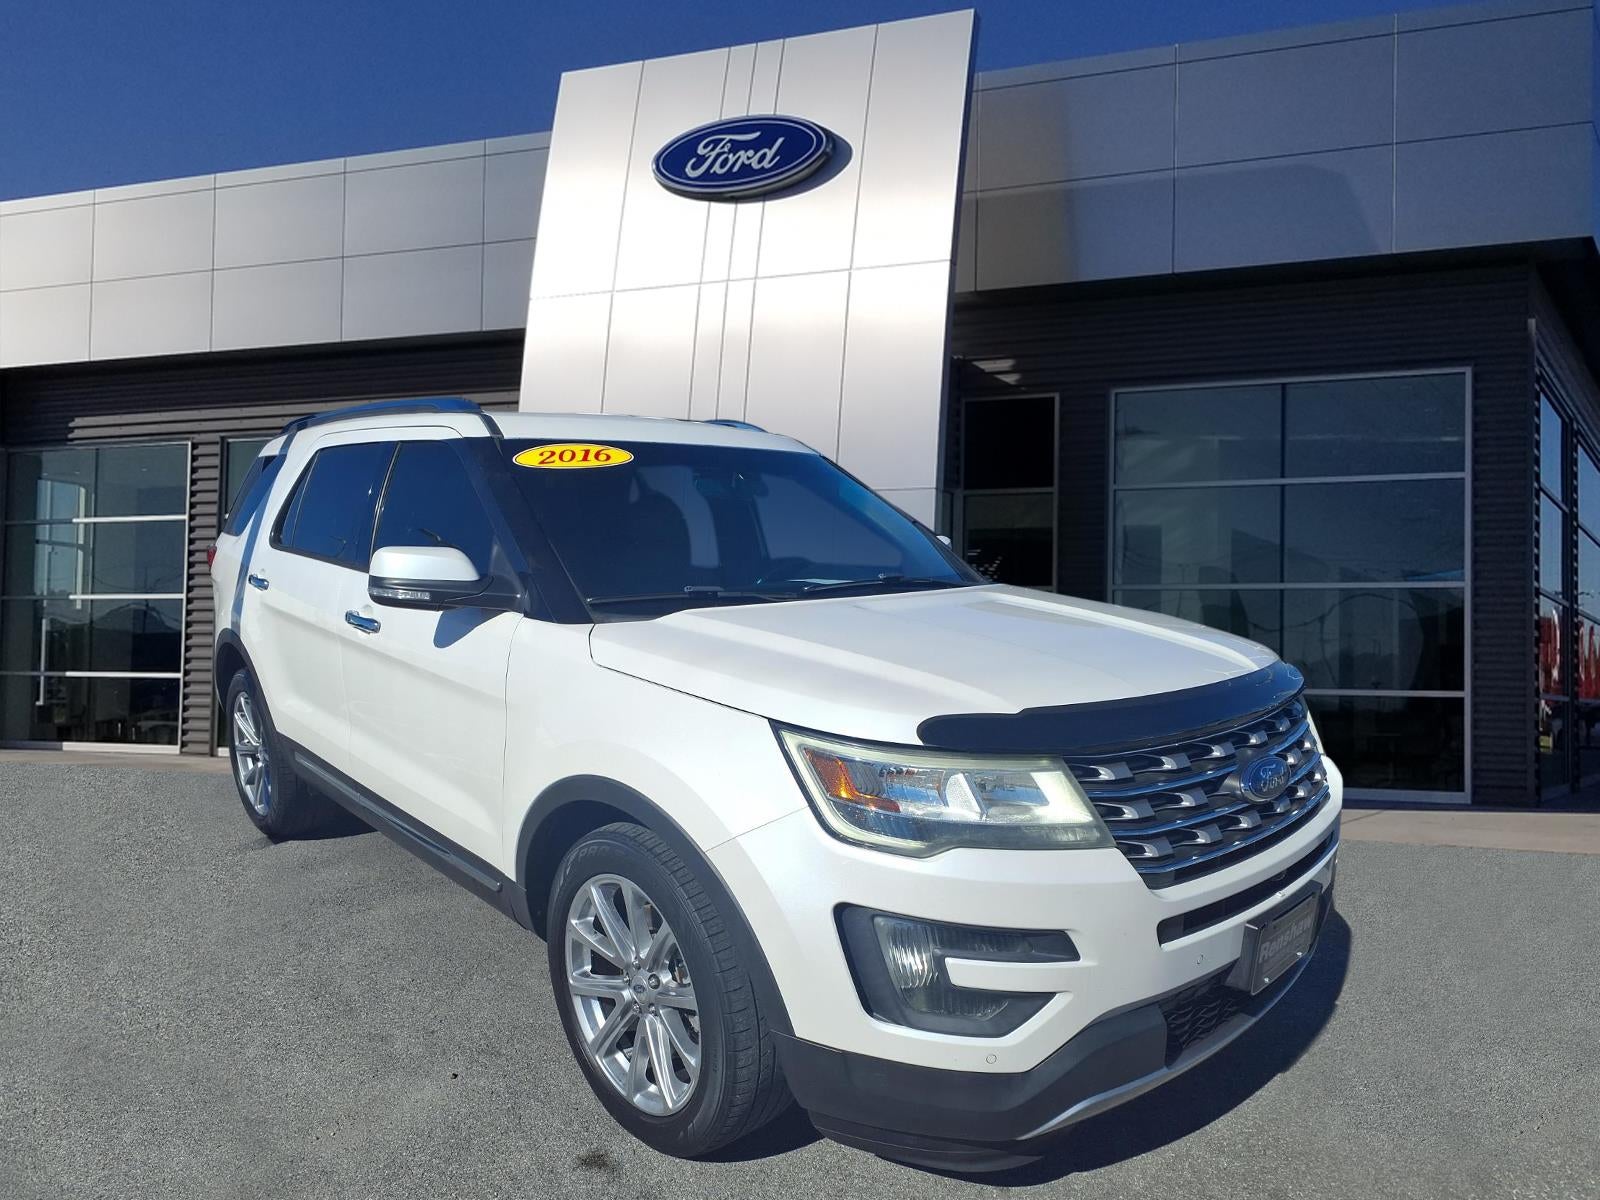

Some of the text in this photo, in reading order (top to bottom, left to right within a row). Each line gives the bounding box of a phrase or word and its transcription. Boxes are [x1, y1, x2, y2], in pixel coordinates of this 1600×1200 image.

[685, 131, 785, 178] Ford
[538, 448, 612, 465] 2016
[1260, 764, 1284, 792] Ford
